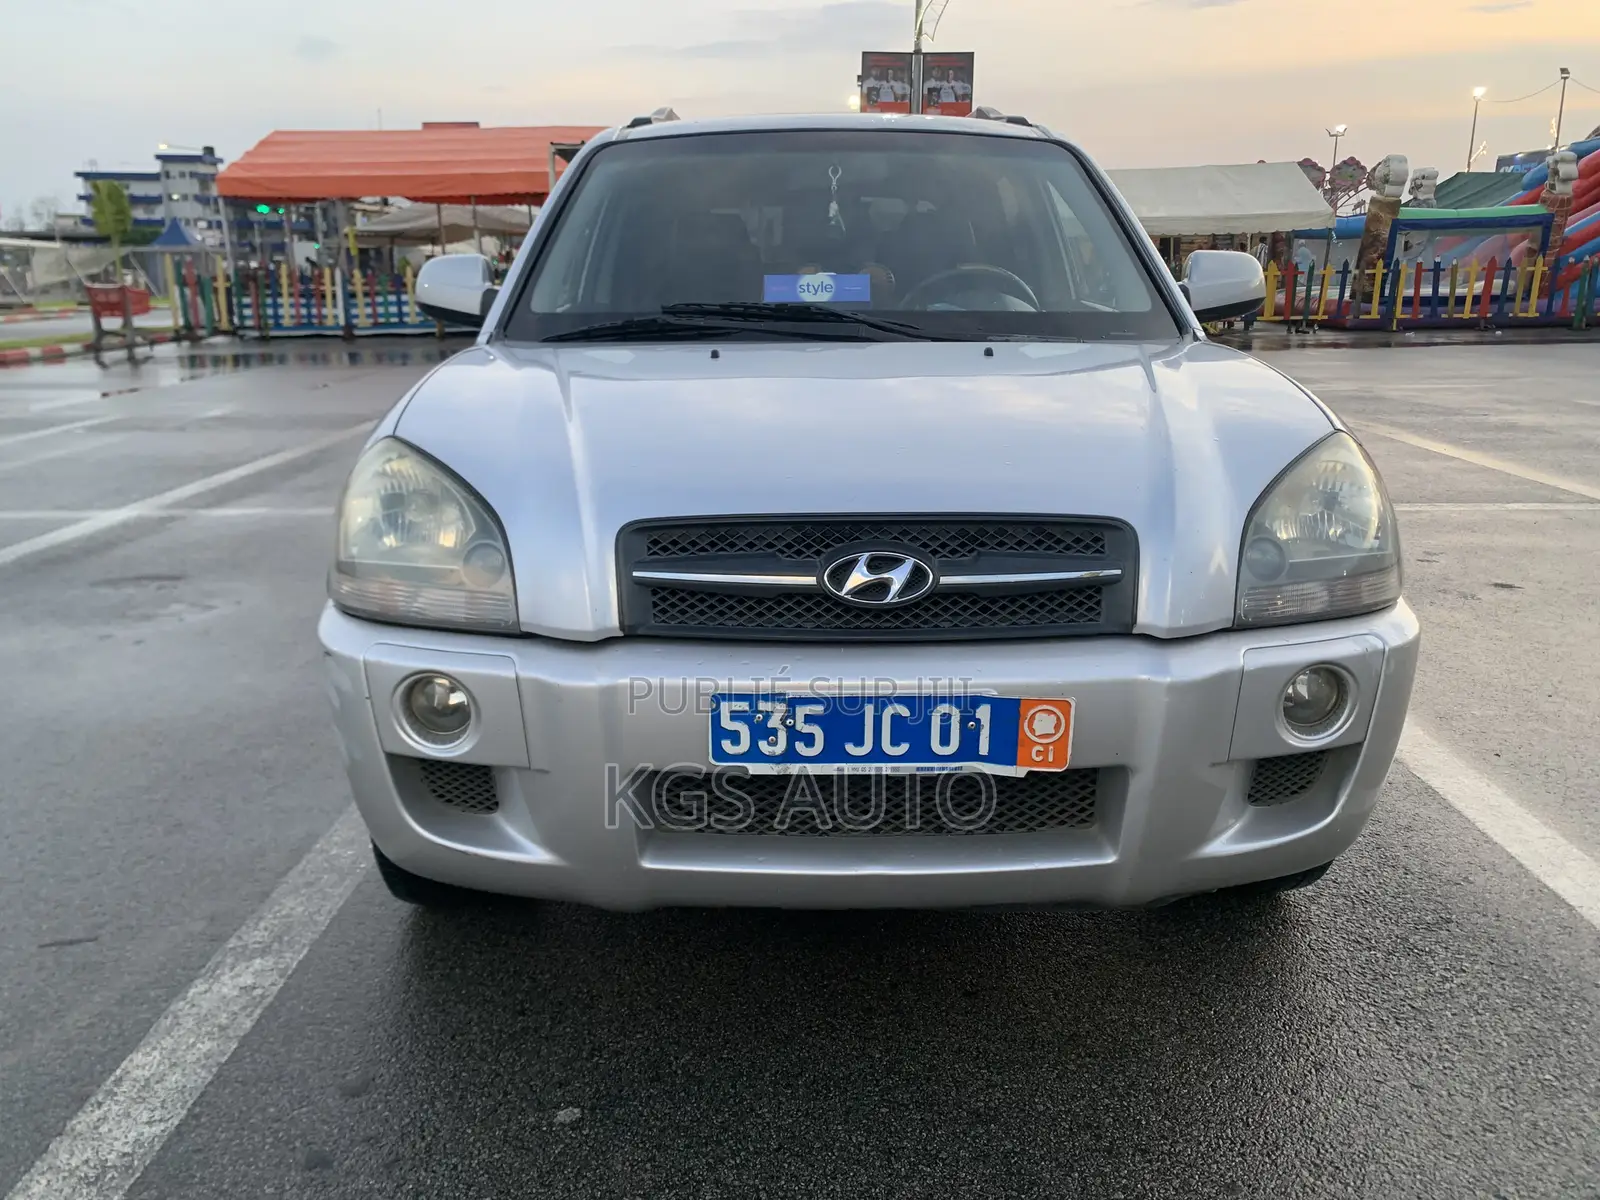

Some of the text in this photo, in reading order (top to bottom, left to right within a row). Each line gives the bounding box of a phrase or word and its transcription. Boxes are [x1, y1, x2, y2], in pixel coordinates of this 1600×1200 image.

[798, 281, 834, 296] style
[720, 700, 992, 757] 535 JC 01
[1031, 744, 1054, 763] CI
